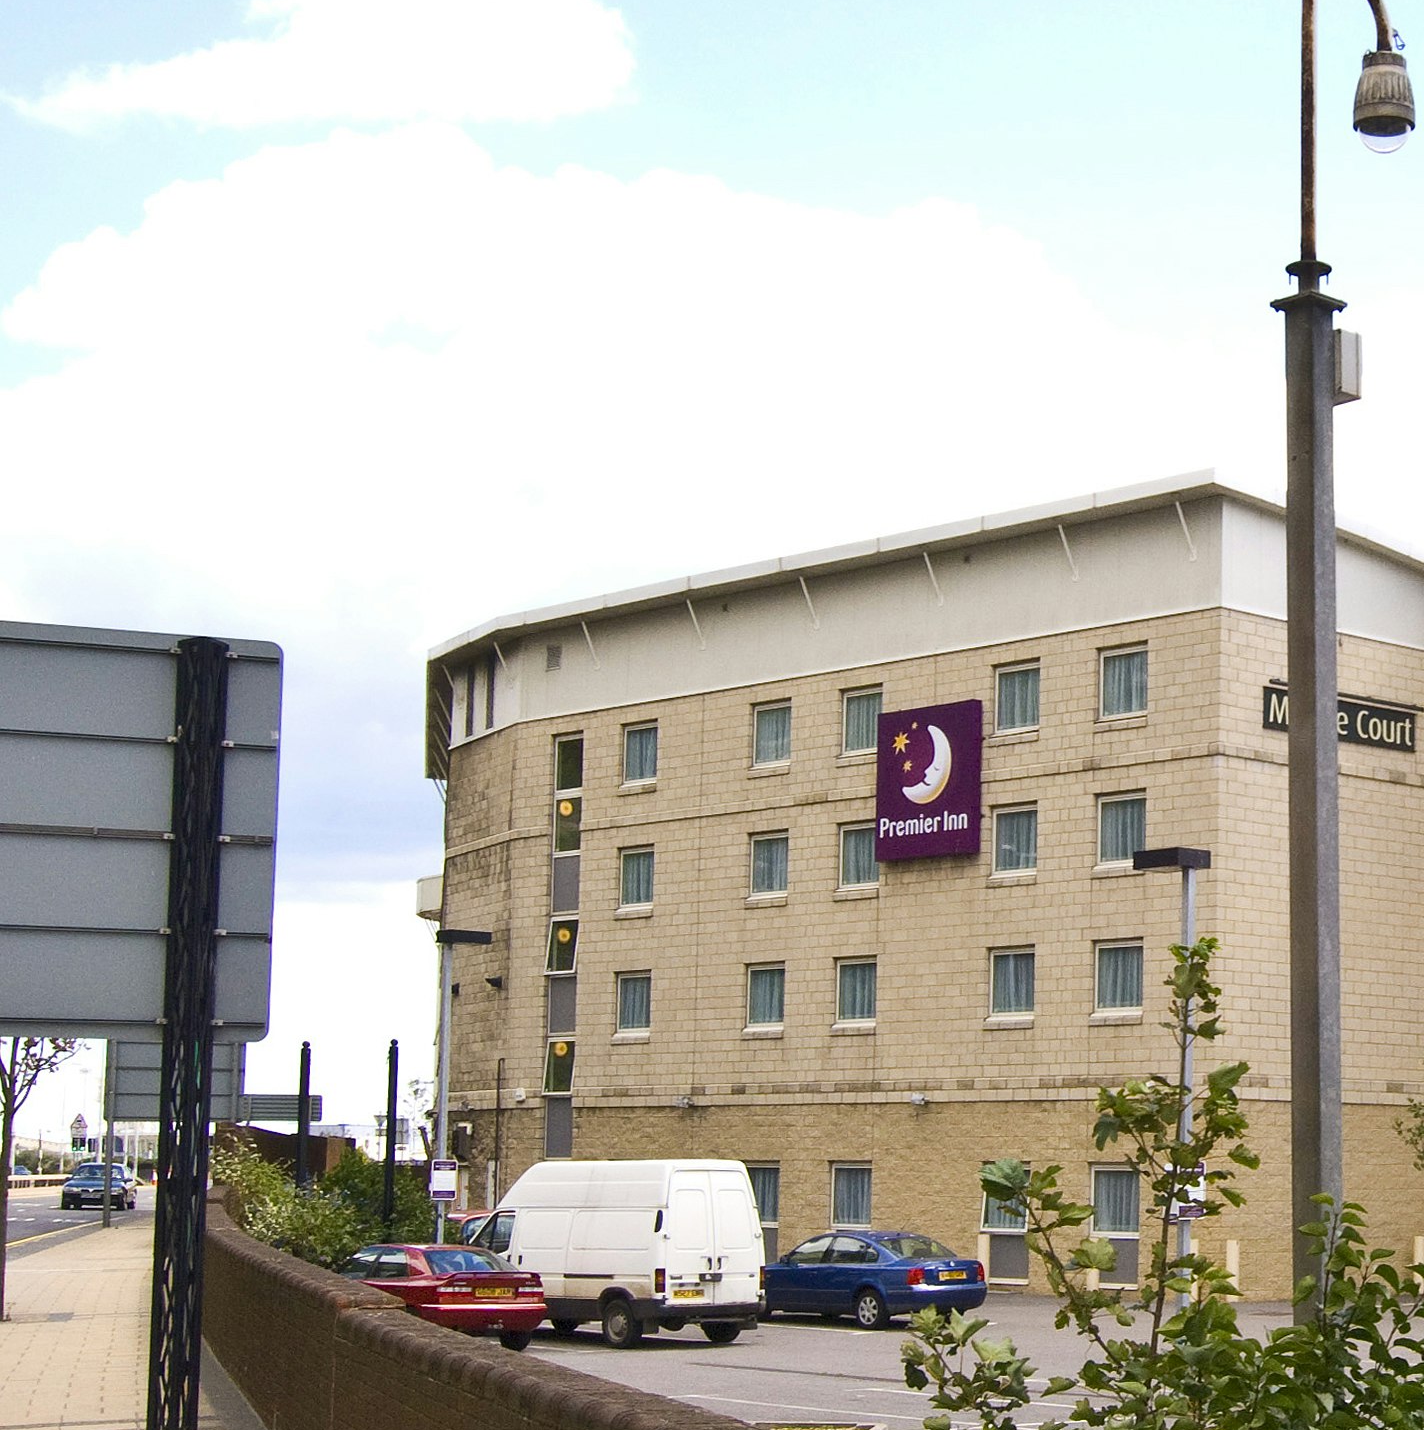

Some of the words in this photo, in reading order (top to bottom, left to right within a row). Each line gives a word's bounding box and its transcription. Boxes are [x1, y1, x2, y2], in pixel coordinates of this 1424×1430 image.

[1356, 709, 1412, 747] Court
[879, 813, 942, 839] Premier
[942, 810, 968, 832] Inn
